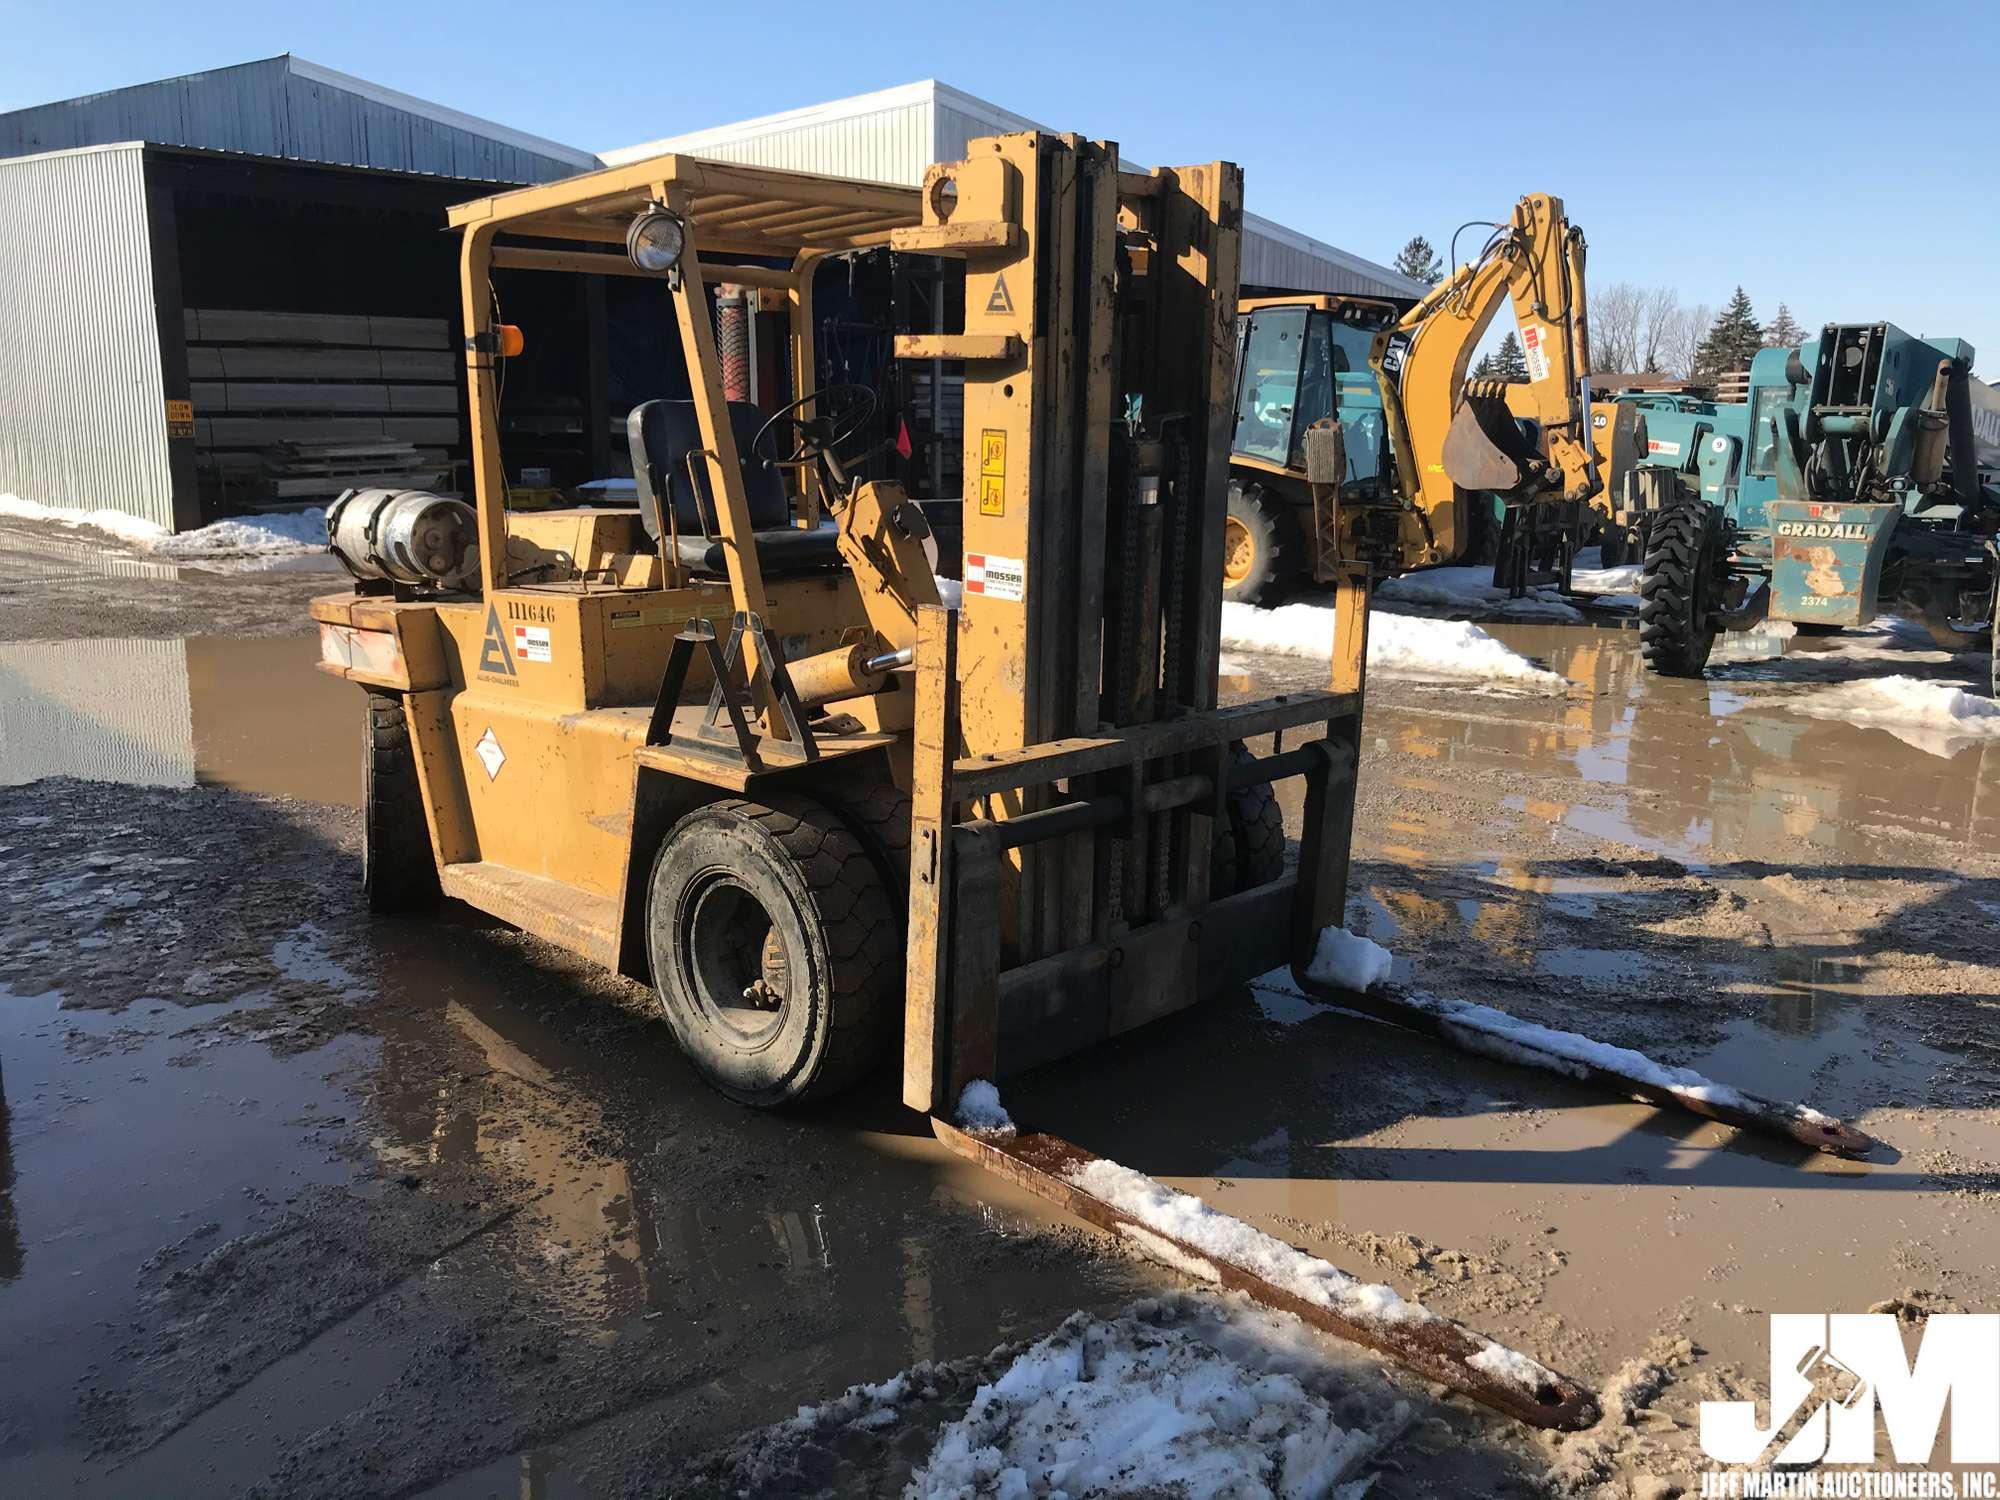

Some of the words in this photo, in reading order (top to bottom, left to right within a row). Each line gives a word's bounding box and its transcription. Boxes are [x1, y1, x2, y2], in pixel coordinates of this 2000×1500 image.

[1383, 336, 1407, 372] CAT
[170, 403, 189, 411] SLOW
[170, 411, 190, 419] DOWN
[1593, 416, 1607, 427] 10
[1778, 522, 1867, 539] GRADALL
[1801, 596, 1828, 606] 2374
[507, 601, 555, 623] 111646
